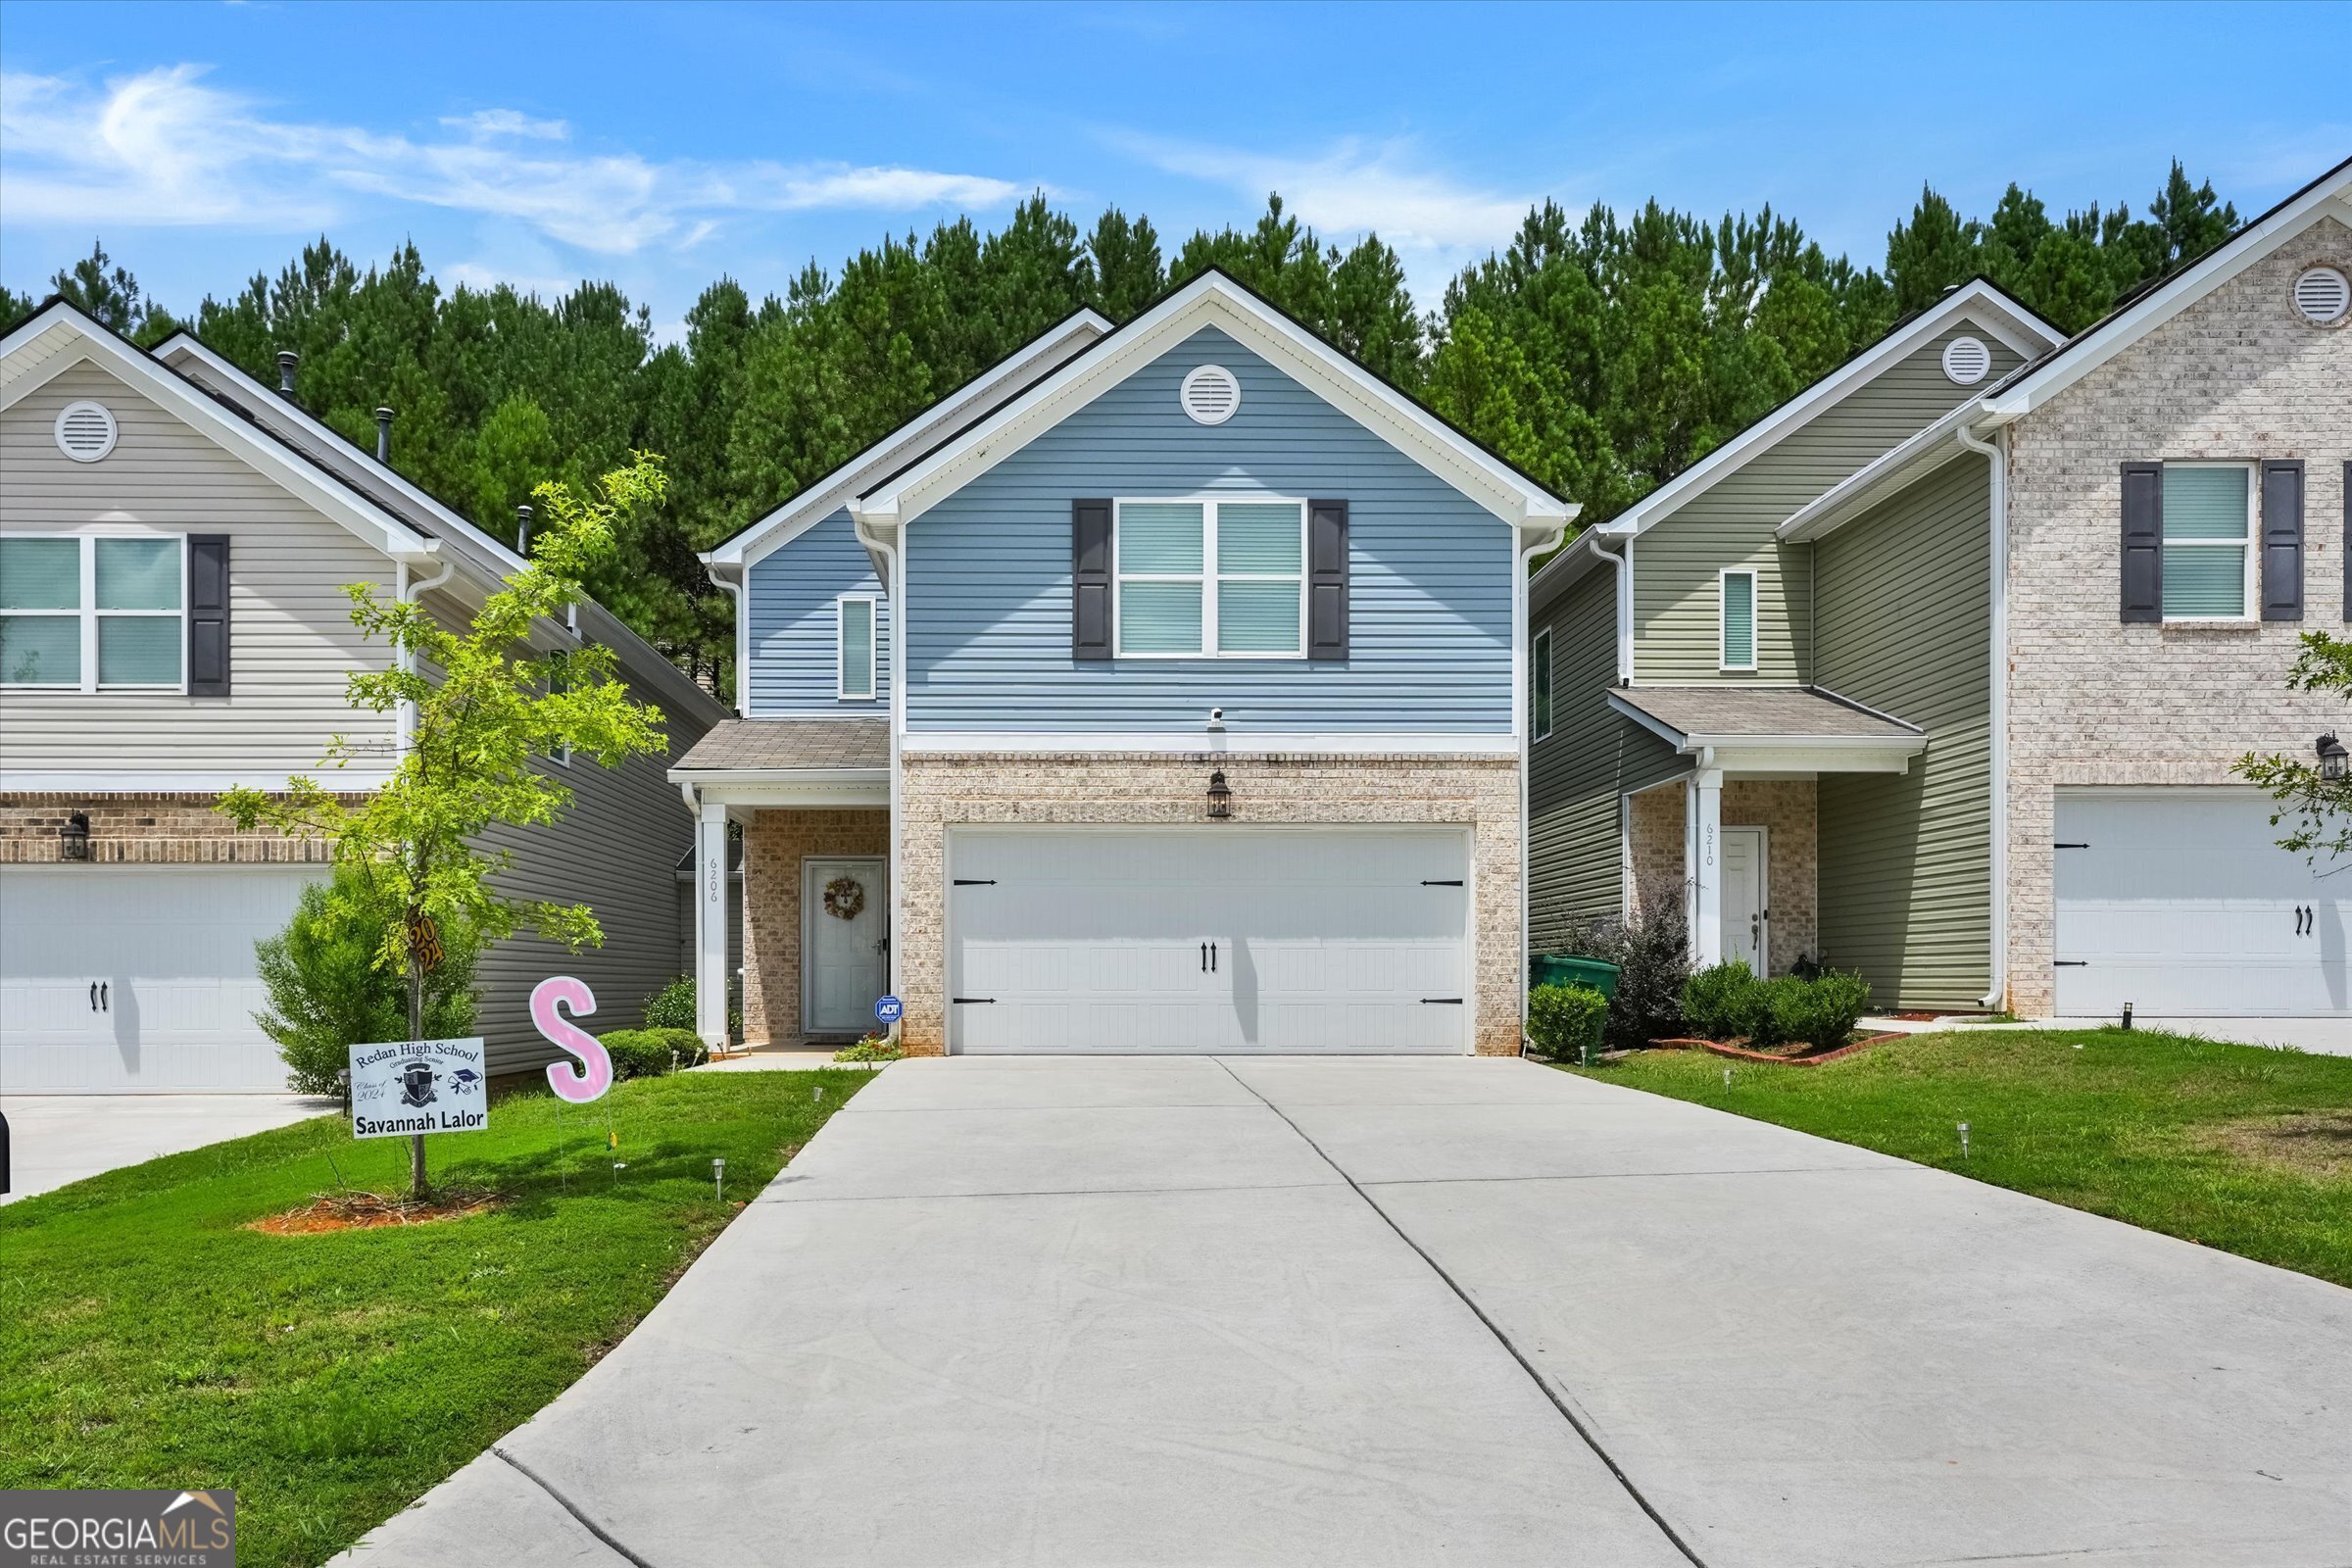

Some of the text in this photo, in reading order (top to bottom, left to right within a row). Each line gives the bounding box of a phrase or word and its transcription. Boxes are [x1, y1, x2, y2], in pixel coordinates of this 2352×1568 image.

[880, 1004, 898, 1014] ADT
[529, 975, 613, 1103] S
[356, 1048, 397, 1069] Redan
[400, 1043, 431, 1056] High
[435, 1043, 479, 1062] School
[389, 1055, 423, 1069] Graduating
[424, 1055, 444, 1065] Senior
[355, 1079, 387, 1090] Class of
[357, 1088, 385, 1102] 2024
[356, 1109, 484, 1135] Savannah Lalor
